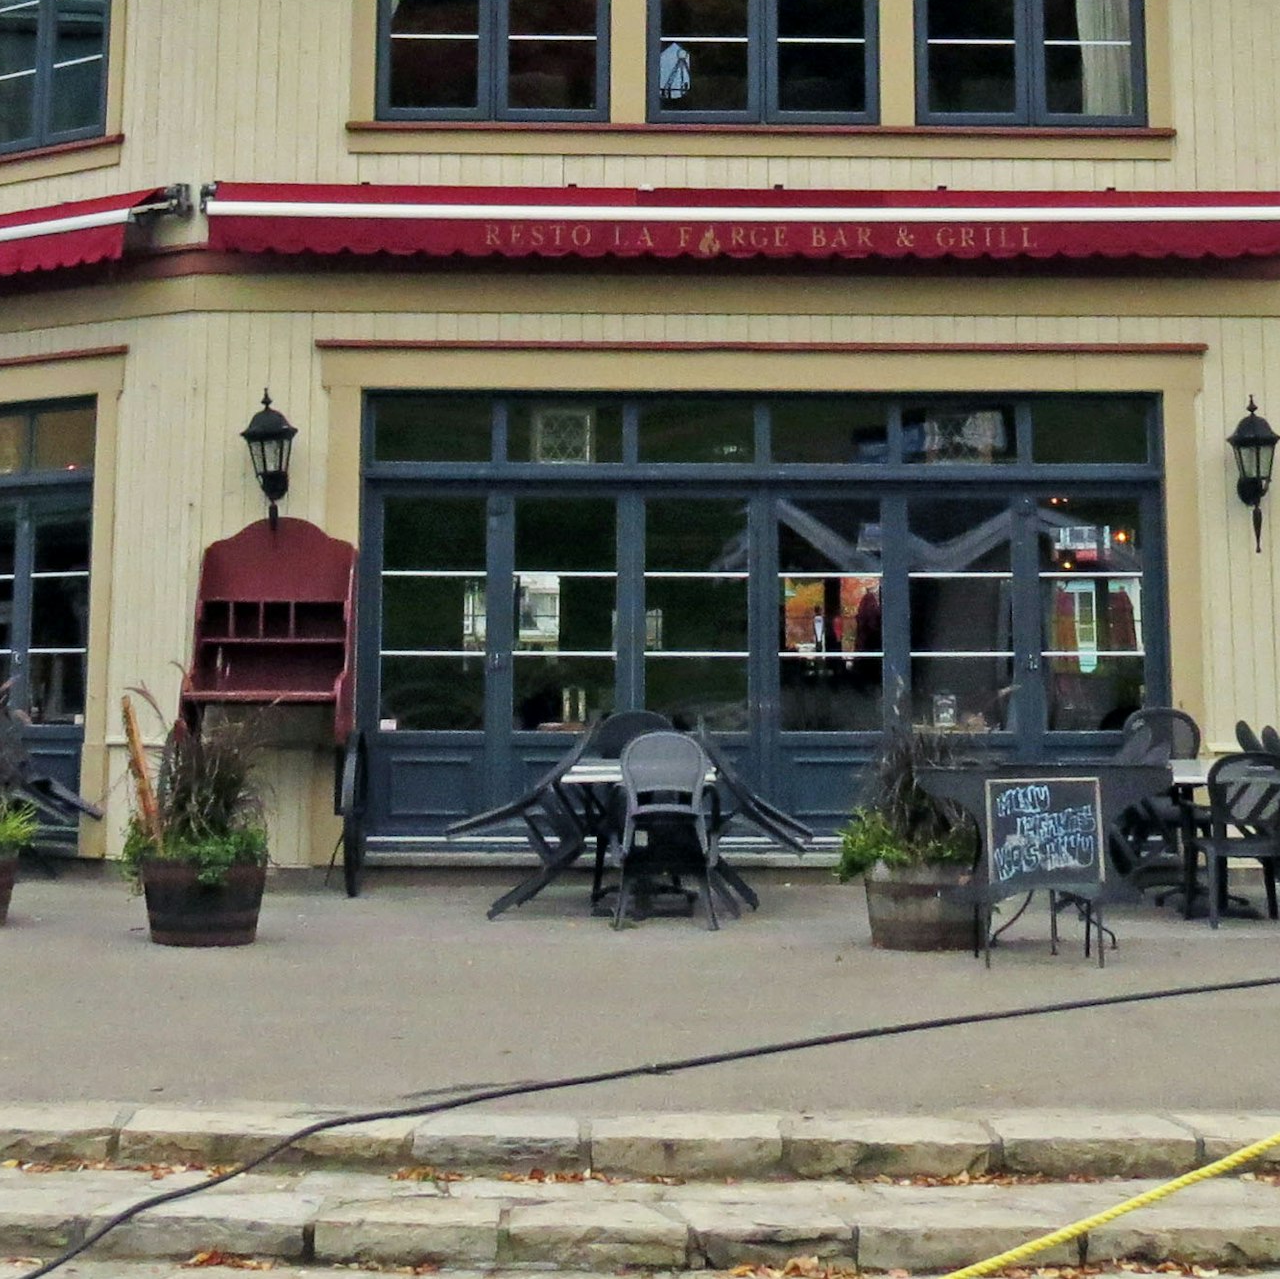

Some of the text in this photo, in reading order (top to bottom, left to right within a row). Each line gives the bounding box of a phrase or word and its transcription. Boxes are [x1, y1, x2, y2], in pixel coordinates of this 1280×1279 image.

[484, 224, 592, 247] RESTO
[614, 225, 655, 247] LA
[811, 226, 874, 248] BAR
[895, 226, 916, 248] &
[935, 226, 1038, 248] GRILL
